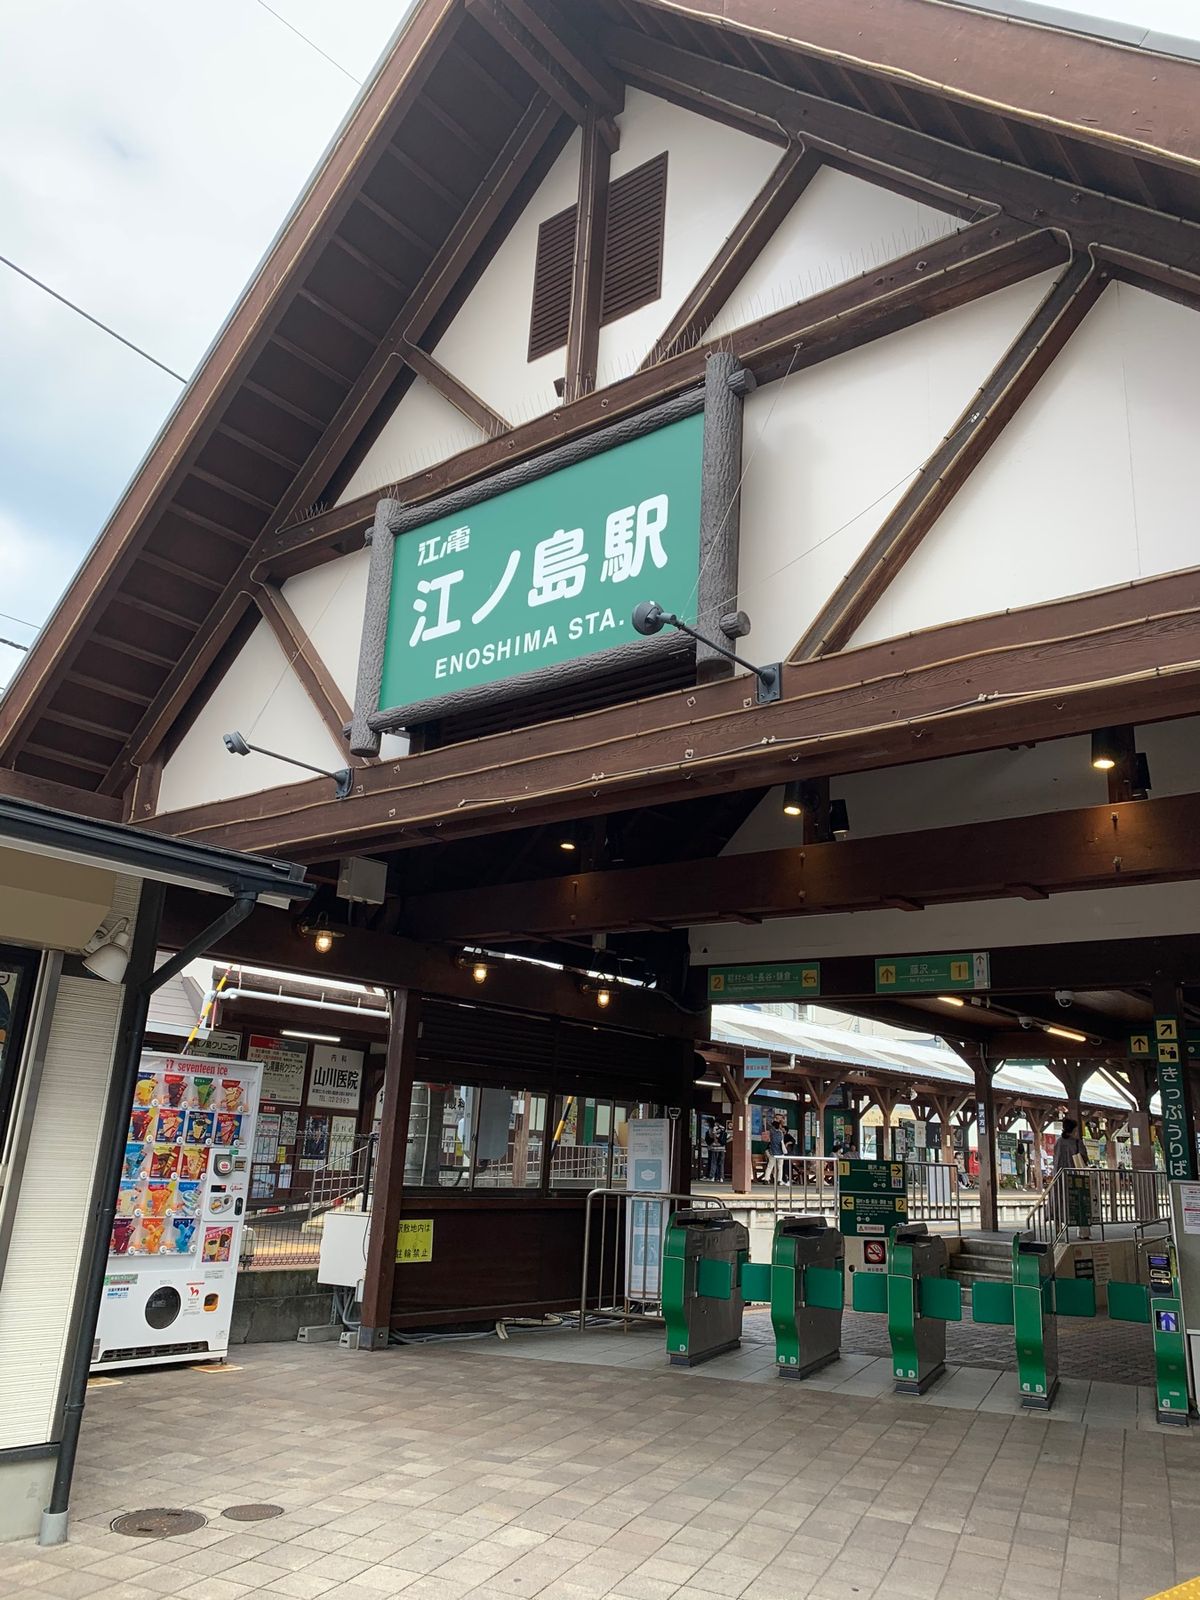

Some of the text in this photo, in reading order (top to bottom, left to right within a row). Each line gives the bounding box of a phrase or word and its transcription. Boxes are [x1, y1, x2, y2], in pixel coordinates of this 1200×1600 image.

[409, 494, 668, 648] 江ノ島駅
[434, 607, 625, 680] ENOSHIMA STA.
[712, 976, 721, 989] 2
[954, 964, 962, 978] 1
[177, 1061, 215, 1075] seventeen
[216, 1063, 228, 1076] ice
[313, 1066, 359, 1090] 山川医院
[1161, 1066, 1188, 1177] きっぷうりば
